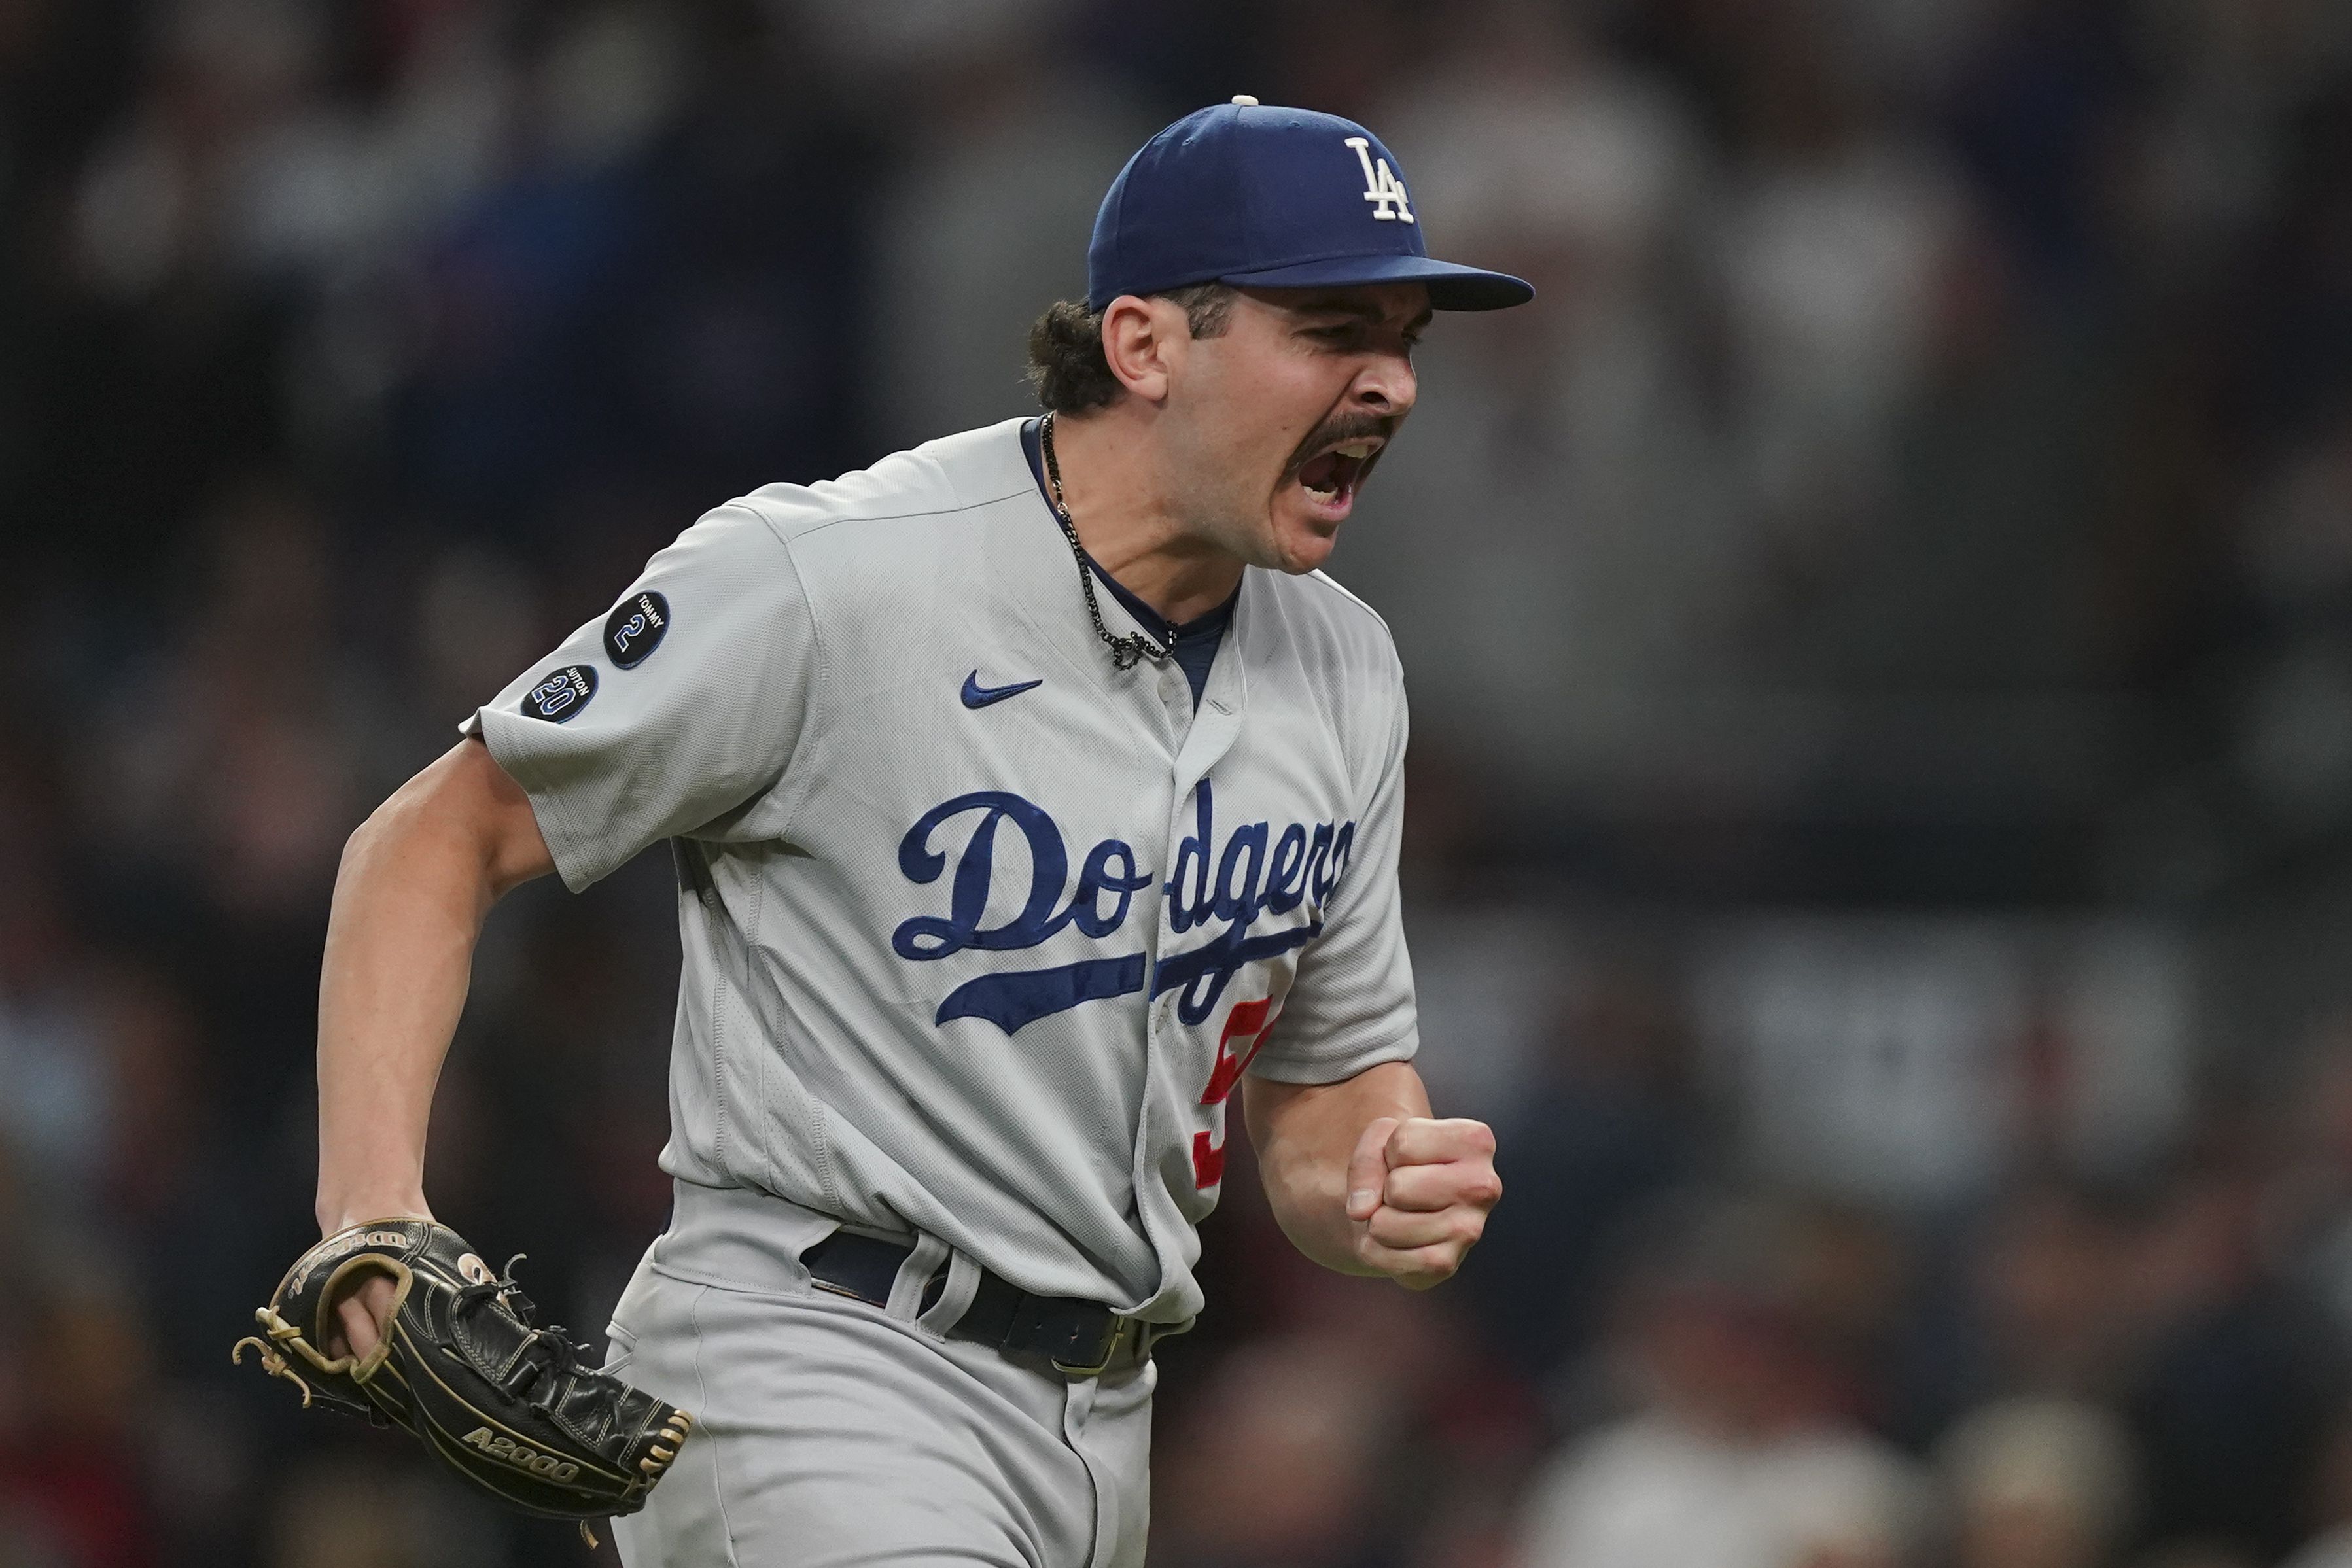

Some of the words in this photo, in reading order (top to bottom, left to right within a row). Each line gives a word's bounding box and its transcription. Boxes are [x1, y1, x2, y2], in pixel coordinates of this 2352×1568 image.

[1344, 137, 1414, 224] LA
[639, 594, 664, 629] TOMMY
[614, 614, 646, 653] 2
[531, 675, 576, 715] 20
[567, 667, 589, 697] SUTTON
[461, 1426, 580, 1483] A2000
